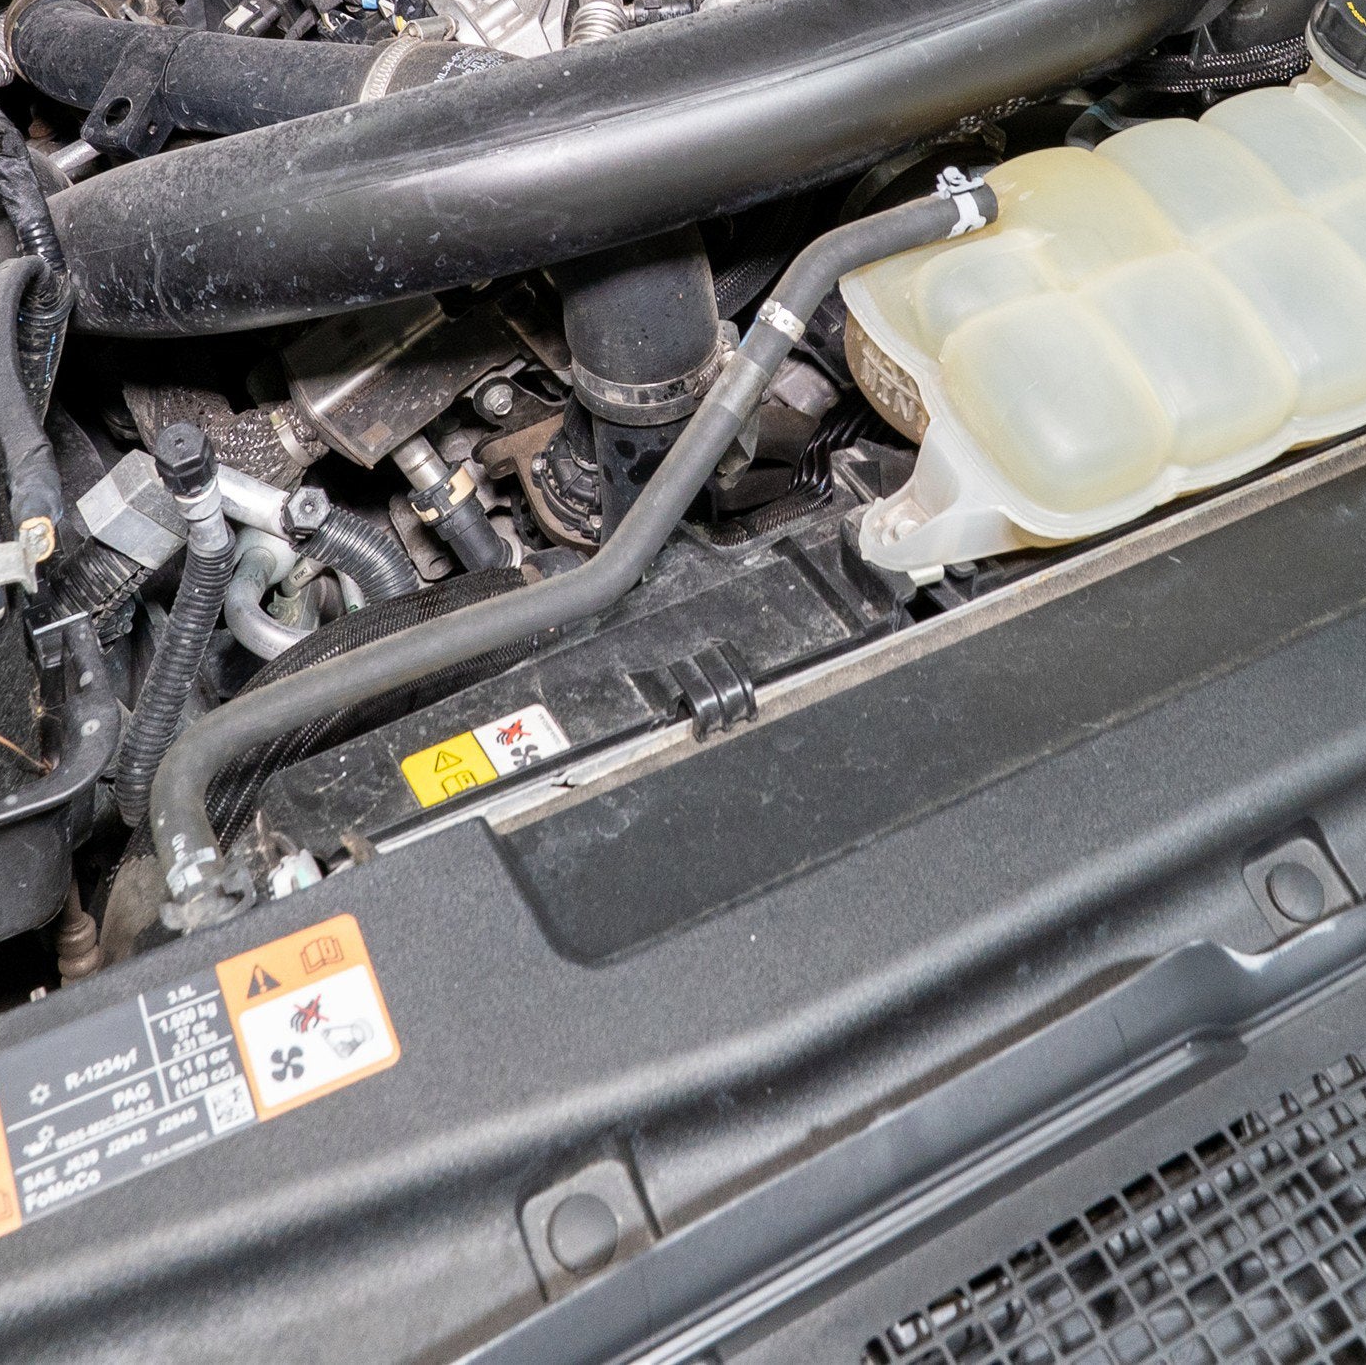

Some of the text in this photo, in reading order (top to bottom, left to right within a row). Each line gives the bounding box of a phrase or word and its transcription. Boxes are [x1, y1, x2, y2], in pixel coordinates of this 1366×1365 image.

[167, 985, 196, 1005] 3.5L
[197, 1001, 218, 1019] kg
[192, 1020, 208, 1034] oz
[209, 1047, 229, 1064] oz
[64, 1047, 137, 1091] R-1234yf
[211, 1061, 235, 1082] cc)
[112, 1082, 151, 1110] PAG
[22, 1167, 57, 1192] SAE
[24, 1170, 100, 1213] FoMoCo
